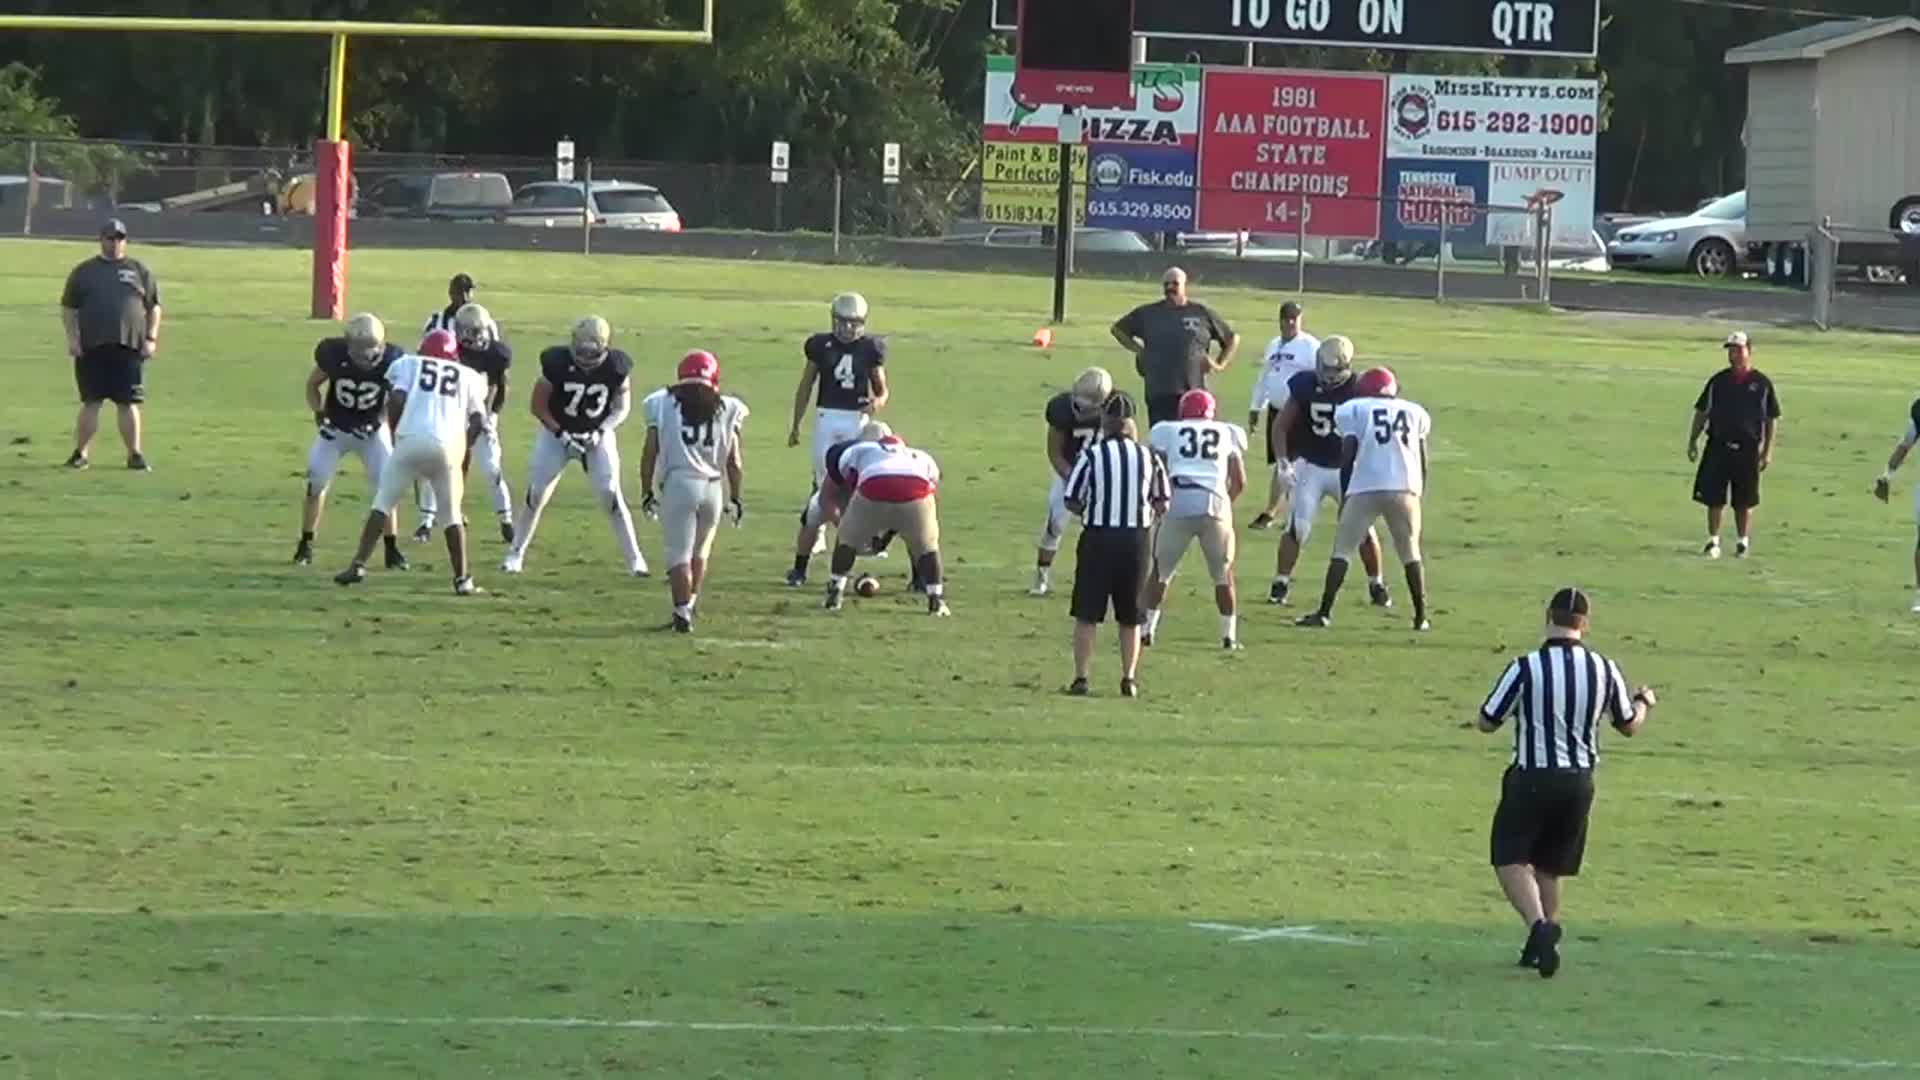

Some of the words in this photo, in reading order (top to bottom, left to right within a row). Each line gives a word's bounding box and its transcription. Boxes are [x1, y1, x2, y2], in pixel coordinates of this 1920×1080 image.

[1284, 0, 1330, 32] GO
[1358, 0, 1405, 35] ON
[1492, 1, 1554, 46] QTR
[1272, 86, 1317, 108] 1981
[1214, 112, 1256, 134] AAA
[1263, 114, 1371, 140] FOOTBALL
[1437, 110, 1594, 136] 615-292-1900
[985, 143, 1025, 162] Paint
[1031, 145, 1043, 163] &
[1255, 143, 1327, 166] STATE
[1128, 169, 1194, 187] Fisk.edu
[1231, 171, 1349, 197] CHAMPIONS
[1492, 165, 1541, 182] JUMP
[1088, 200, 1192, 219] 615.329.8500
[418, 359, 461, 398] 52
[833, 353, 856, 390] 4
[334, 377, 382, 411] 62
[562, 382, 610, 419] 73
[1309, 402, 1343, 438] 5
[1372, 407, 1412, 448] 54
[1178, 426, 1221, 460] 32
